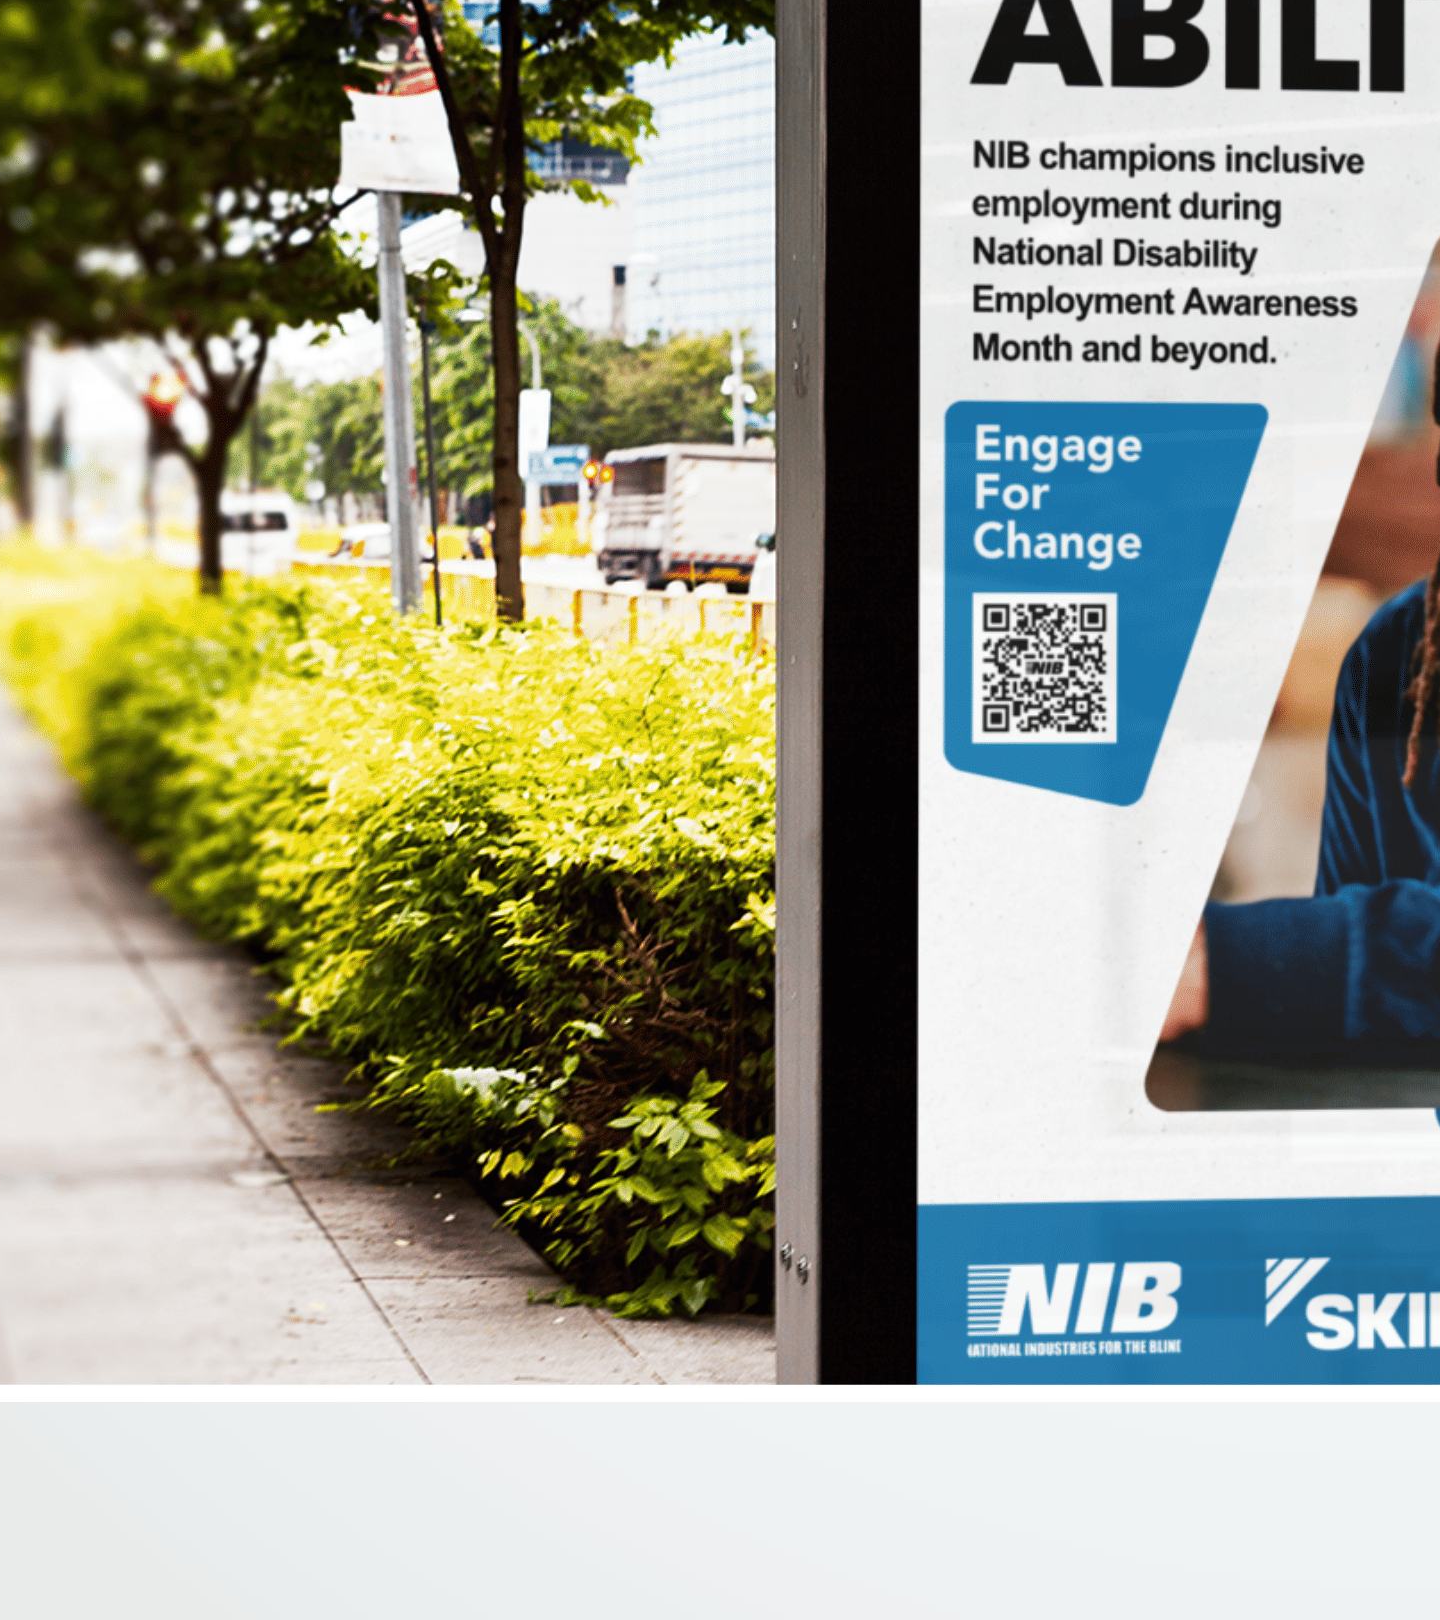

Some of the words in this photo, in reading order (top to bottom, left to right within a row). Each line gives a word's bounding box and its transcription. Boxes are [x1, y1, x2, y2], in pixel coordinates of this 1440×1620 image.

[973, 139, 1030, 169] NIB
[1039, 141, 1216, 178] champions
[1225, 144, 1365, 175] inclusive
[972, 189, 1171, 226] employment
[1179, 191, 1282, 229] during
[973, 236, 1103, 267] National
[1113, 238, 1258, 276] Disability
[973, 284, 1175, 322] Employment
[1182, 287, 1358, 318] Awareness
[973, 332, 1073, 362] Month
[1081, 334, 1141, 363] and
[1151, 334, 1277, 371] beyond.
[976, 424, 1142, 473] Engage
[976, 473, 1050, 510] For
[974, 520, 1142, 571] Change
[1023, 658, 1066, 676] NIB
[967, 1261, 1181, 1336] NIB
[1024, 1340, 1097, 1357] INDUSTRIES
[1098, 1340, 1122, 1355] FOR
[1124, 1339, 1147, 1354] THE
